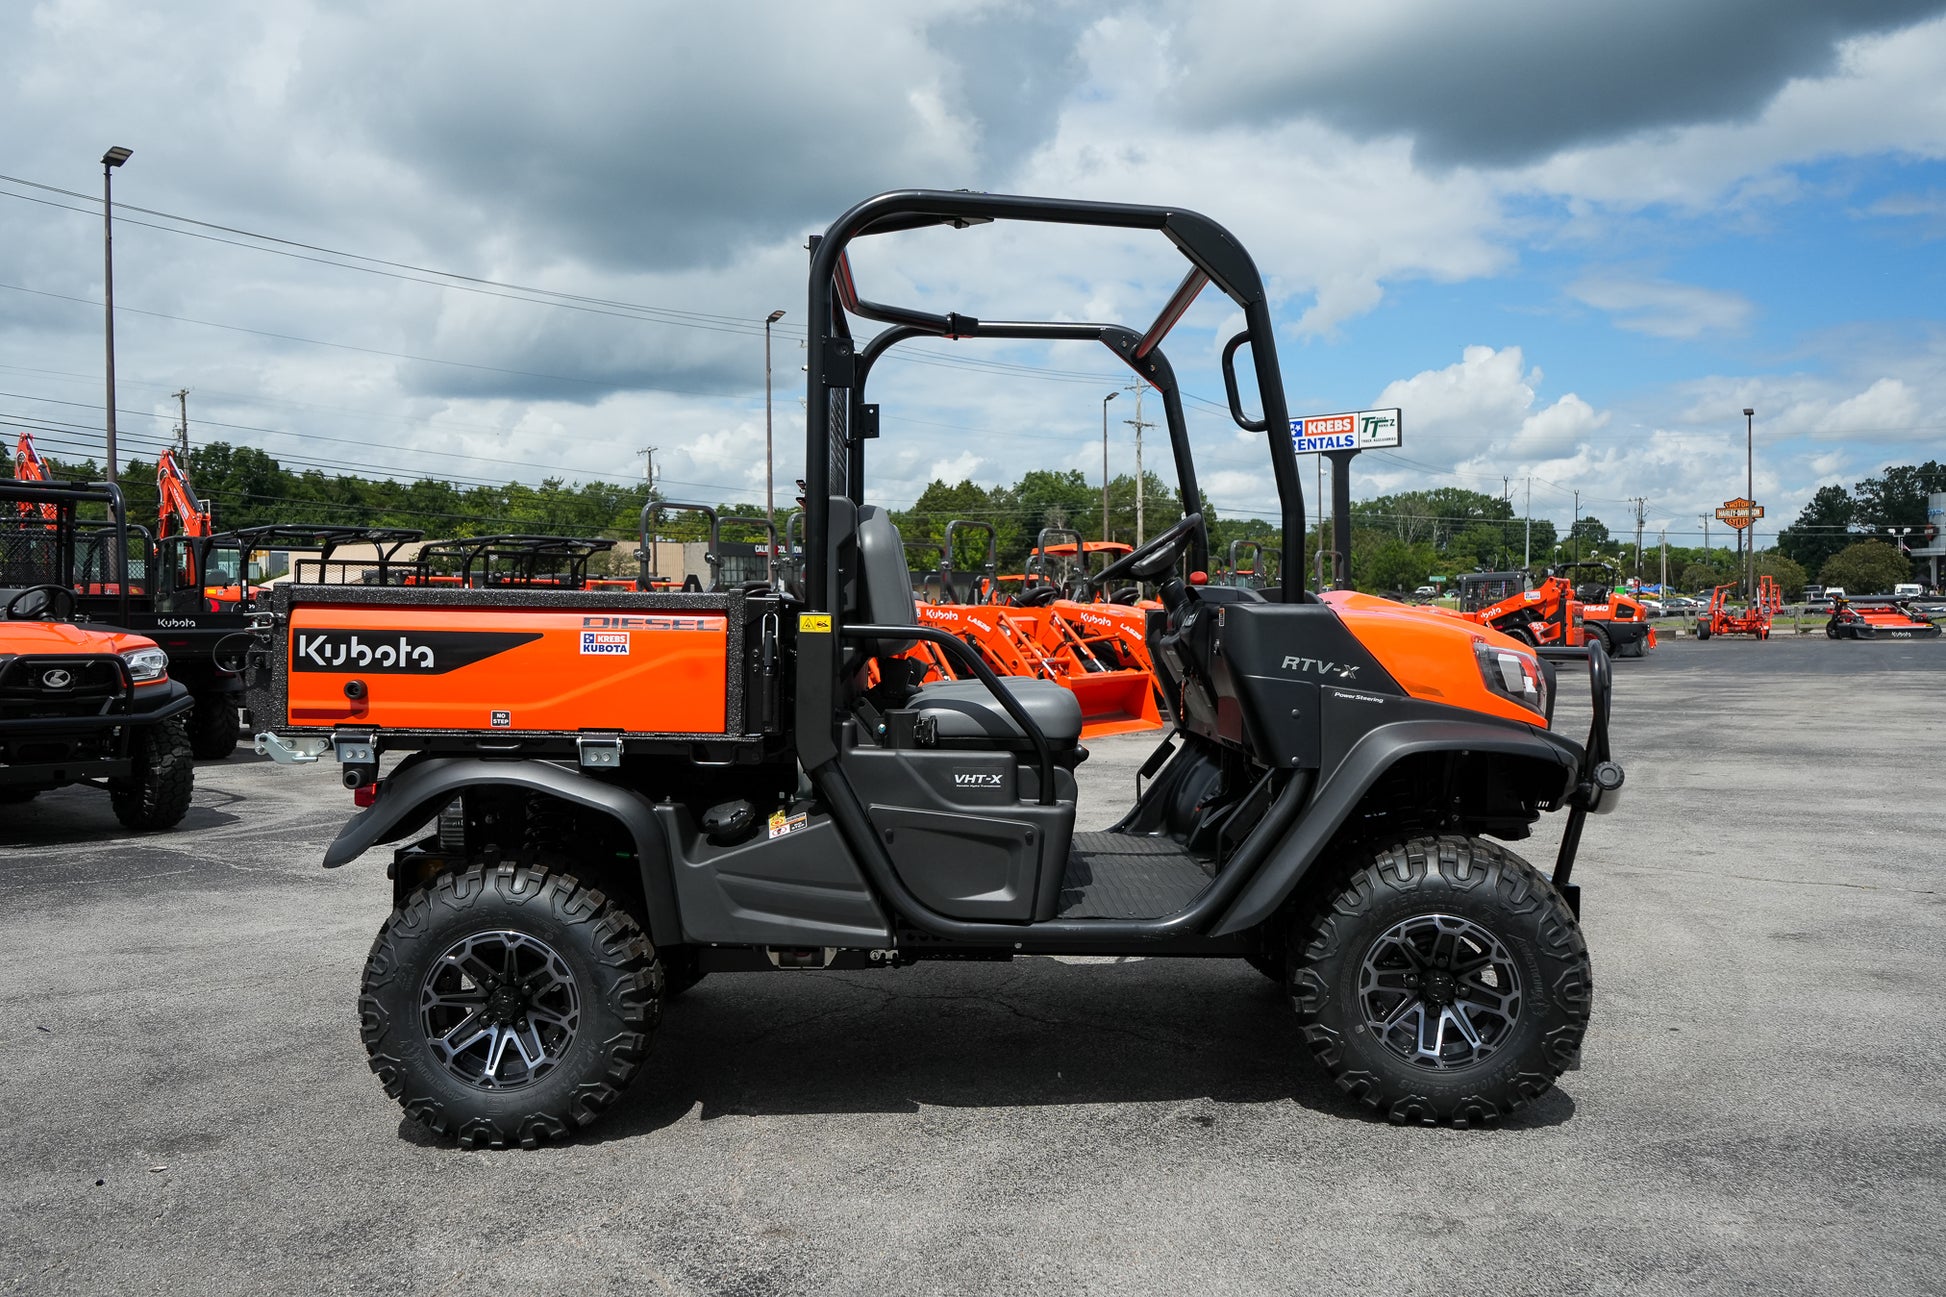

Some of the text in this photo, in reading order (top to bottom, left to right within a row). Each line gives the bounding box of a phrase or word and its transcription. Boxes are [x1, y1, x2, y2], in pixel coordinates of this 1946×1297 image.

[1307, 418, 1351, 434] KREBS
[926, 609, 958, 620] Kubota
[1080, 612, 1112, 627] Kubota
[157, 618, 196, 628] Kubota
[583, 617, 720, 631] DIESEL
[597, 635, 626, 643] KREBS
[299, 635, 435, 668] Kubota
[583, 644, 627, 653] KUBOTA
[1281, 655, 1360, 679] RTV-X
[1334, 691, 1384, 704] Power Steering
[954, 774, 1003, 784] VHT-X
